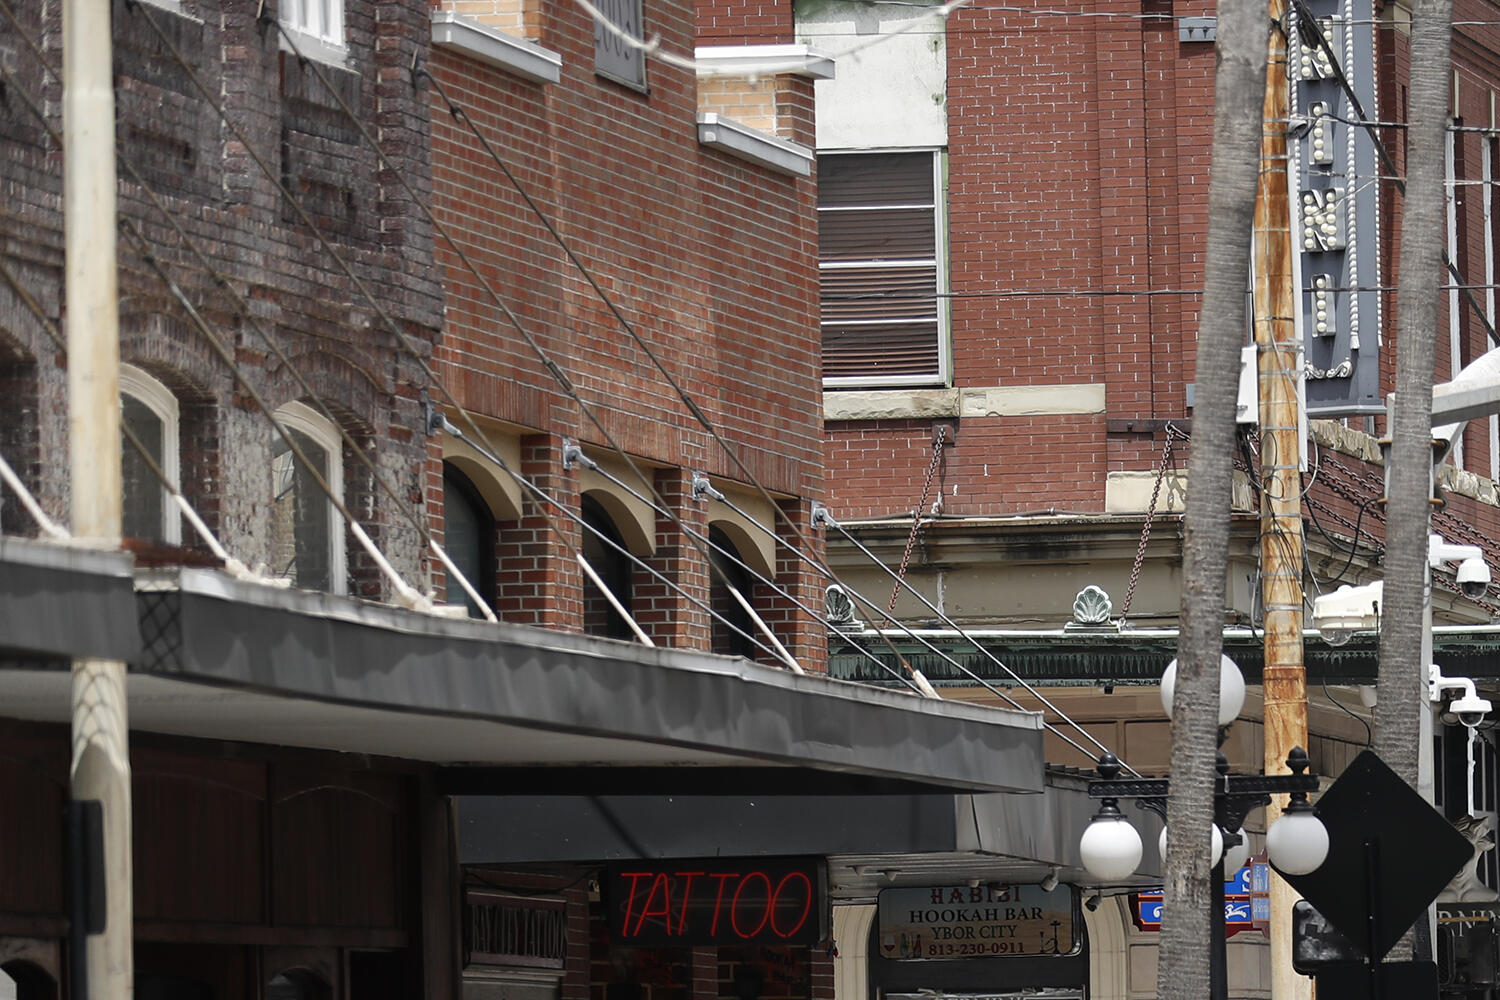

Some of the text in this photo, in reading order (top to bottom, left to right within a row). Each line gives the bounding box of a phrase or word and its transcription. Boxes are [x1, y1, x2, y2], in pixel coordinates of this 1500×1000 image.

[620, 871, 811, 938] TATTOO
[909, 906, 1044, 923] HOOKAH BAR
[931, 924, 1018, 940] YBOR CITY
[928, 942, 1025, 956] 813-230-0911
